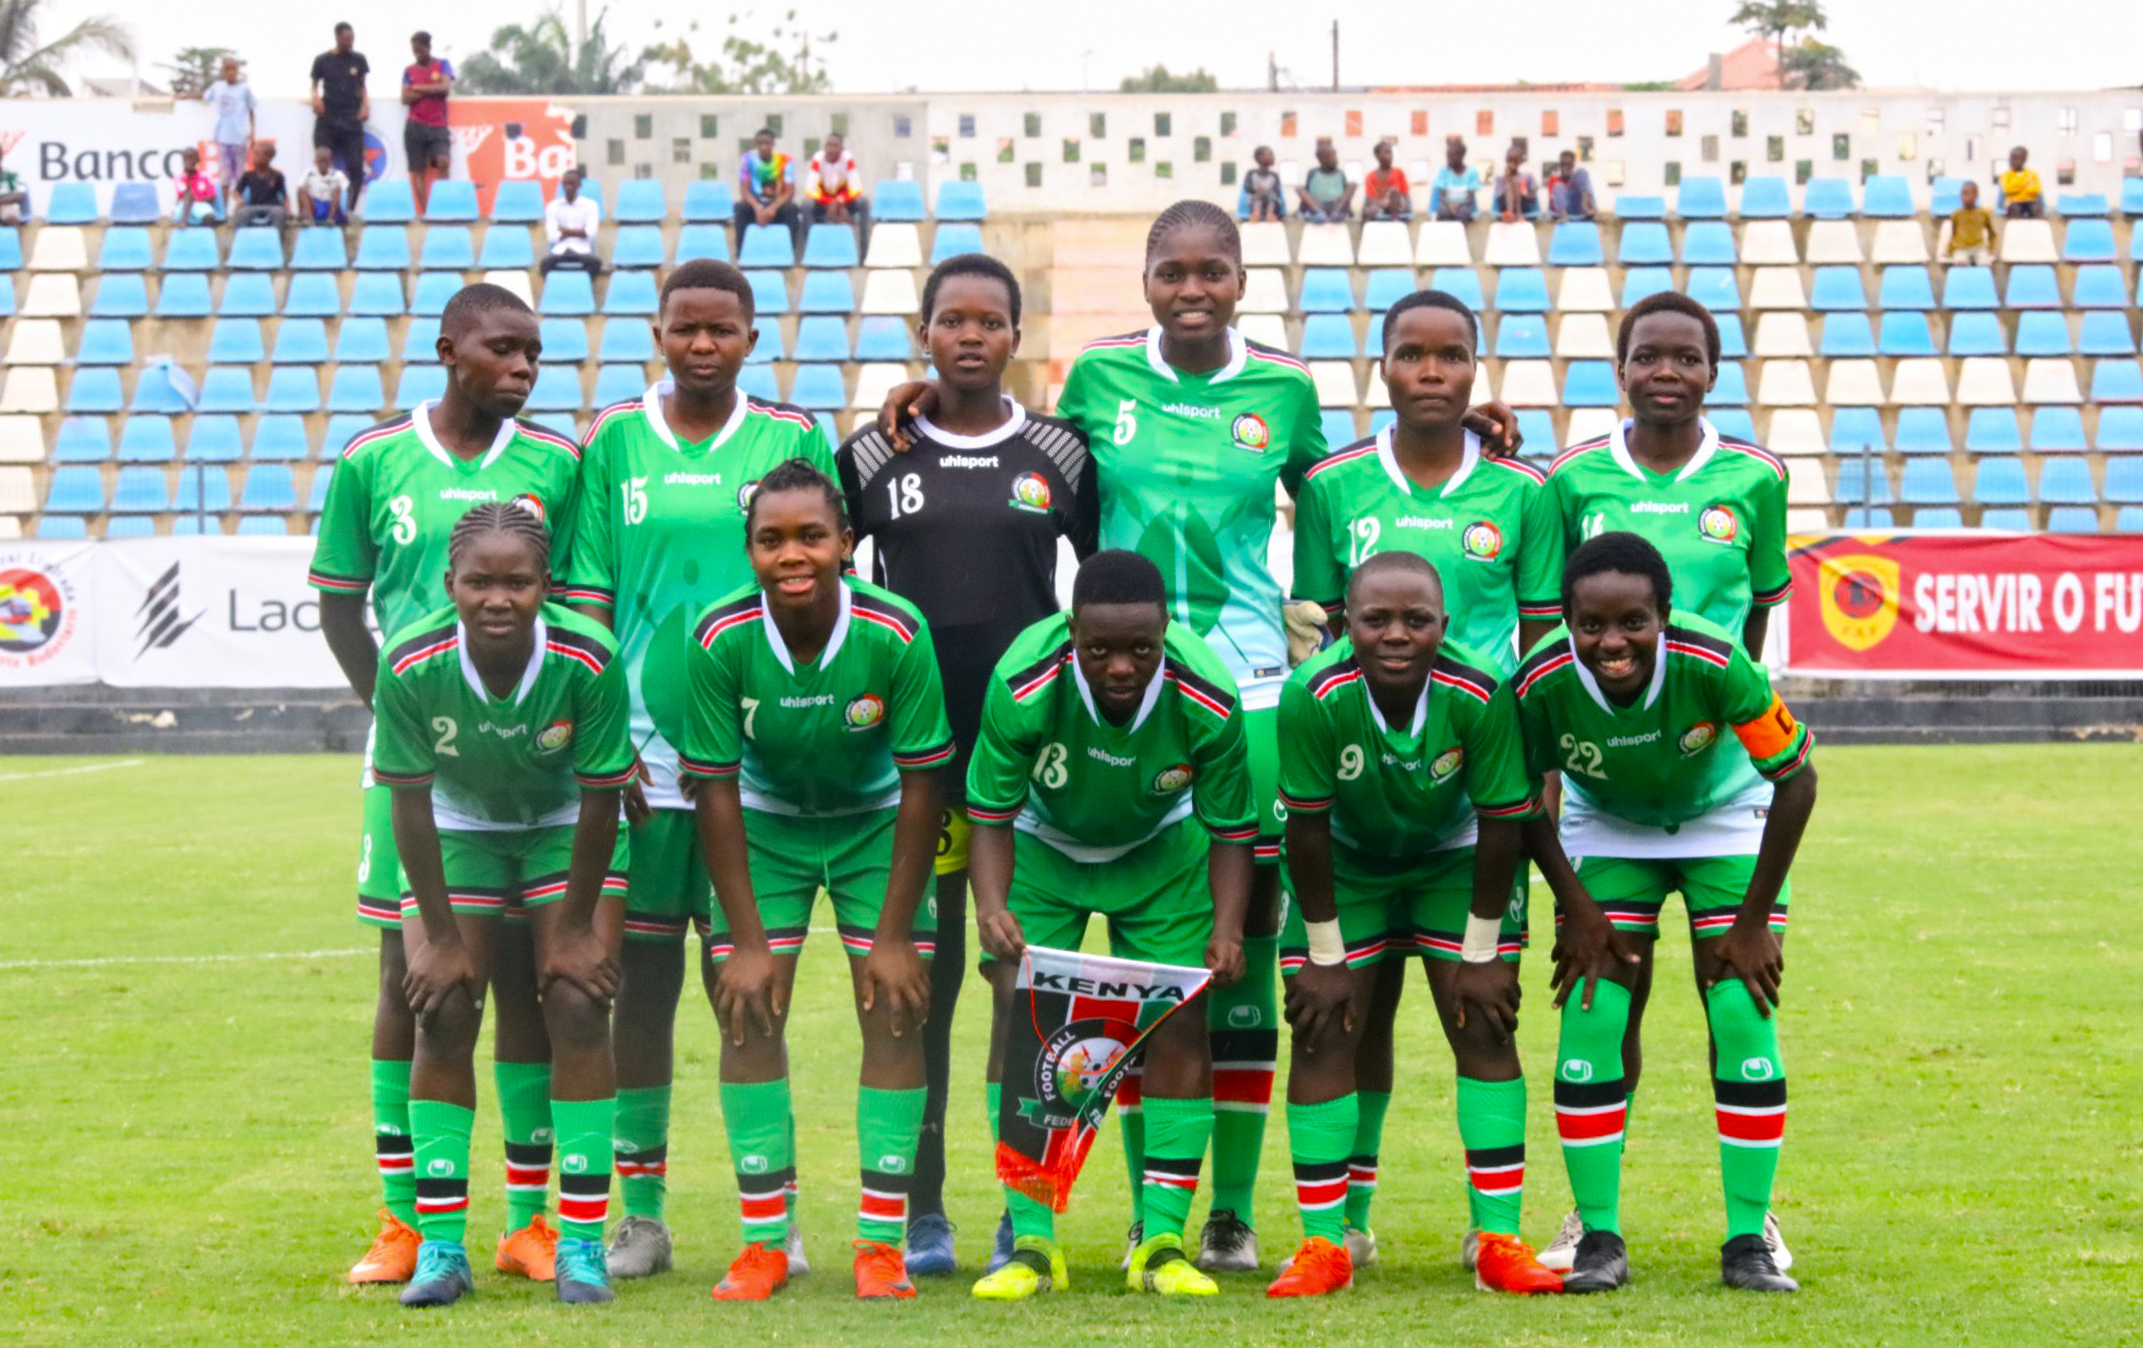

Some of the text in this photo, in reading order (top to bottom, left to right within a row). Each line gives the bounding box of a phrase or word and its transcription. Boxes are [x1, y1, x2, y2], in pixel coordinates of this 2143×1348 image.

[1113, 398, 1137, 446] 5
[1162, 403, 1220, 419] uhlsport
[664, 472, 721, 486] uhlsport
[939, 455, 999, 469] uhlsport
[439, 487, 498, 501] uhlsport
[620, 475, 648, 526] 15
[887, 472, 924, 520] 18
[1630, 501, 1689, 514] uhlsport
[390, 495, 417, 545] 3
[1395, 515, 1454, 530] uhlsport
[1347, 516, 1381, 568] 12
[1914, 571, 2143, 633] SERVIR O FU
[740, 695, 760, 740] 7
[779, 693, 834, 708] uhlsport
[431, 716, 460, 757] 2
[478, 720, 528, 740] uhsport
[1606, 729, 1662, 748] uhlsport
[1032, 742, 1068, 789] 13
[1337, 743, 1364, 780] 9
[1560, 733, 1609, 780] 22
[1033, 971, 1185, 1001] KENYA
[1041, 1031, 1076, 1102] FOOTBALL
[1104, 1056, 1136, 1098] FOOT
